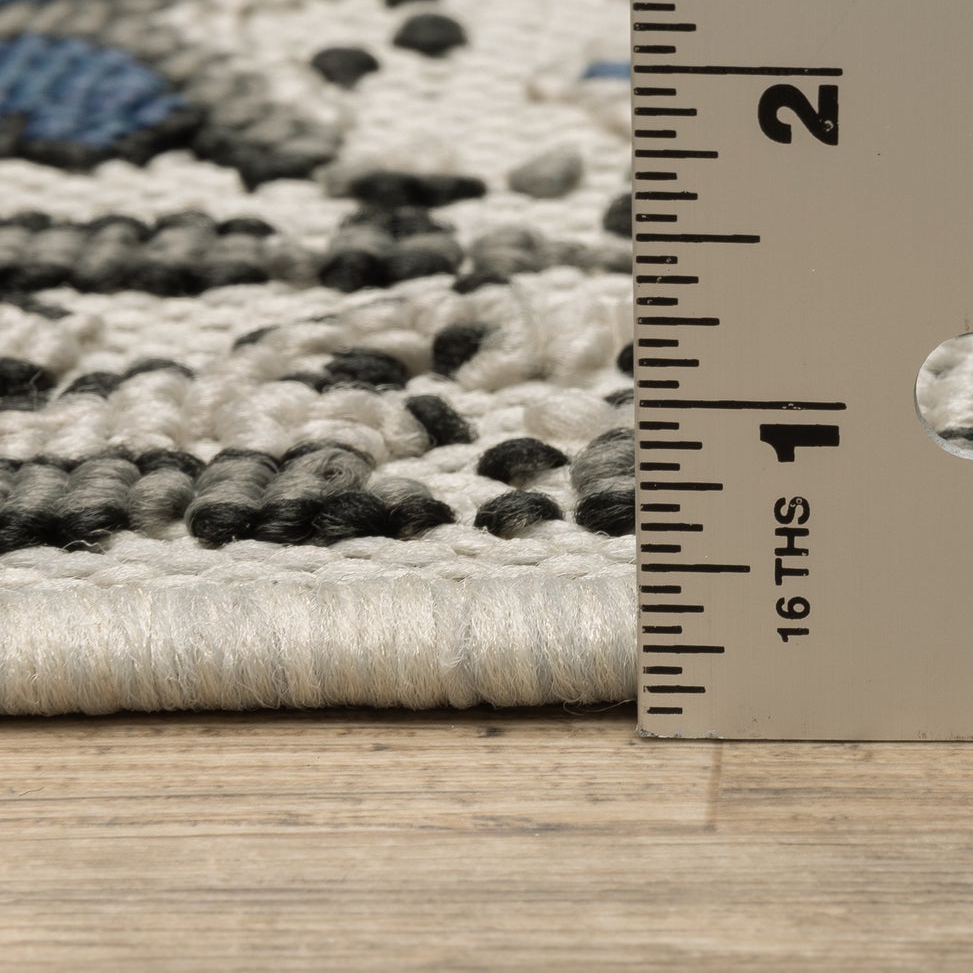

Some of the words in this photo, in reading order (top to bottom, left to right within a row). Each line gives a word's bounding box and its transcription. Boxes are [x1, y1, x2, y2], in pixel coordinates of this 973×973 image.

[757, 83, 840, 147] 2
[759, 423, 840, 463] 1
[773, 495, 811, 586] THS
